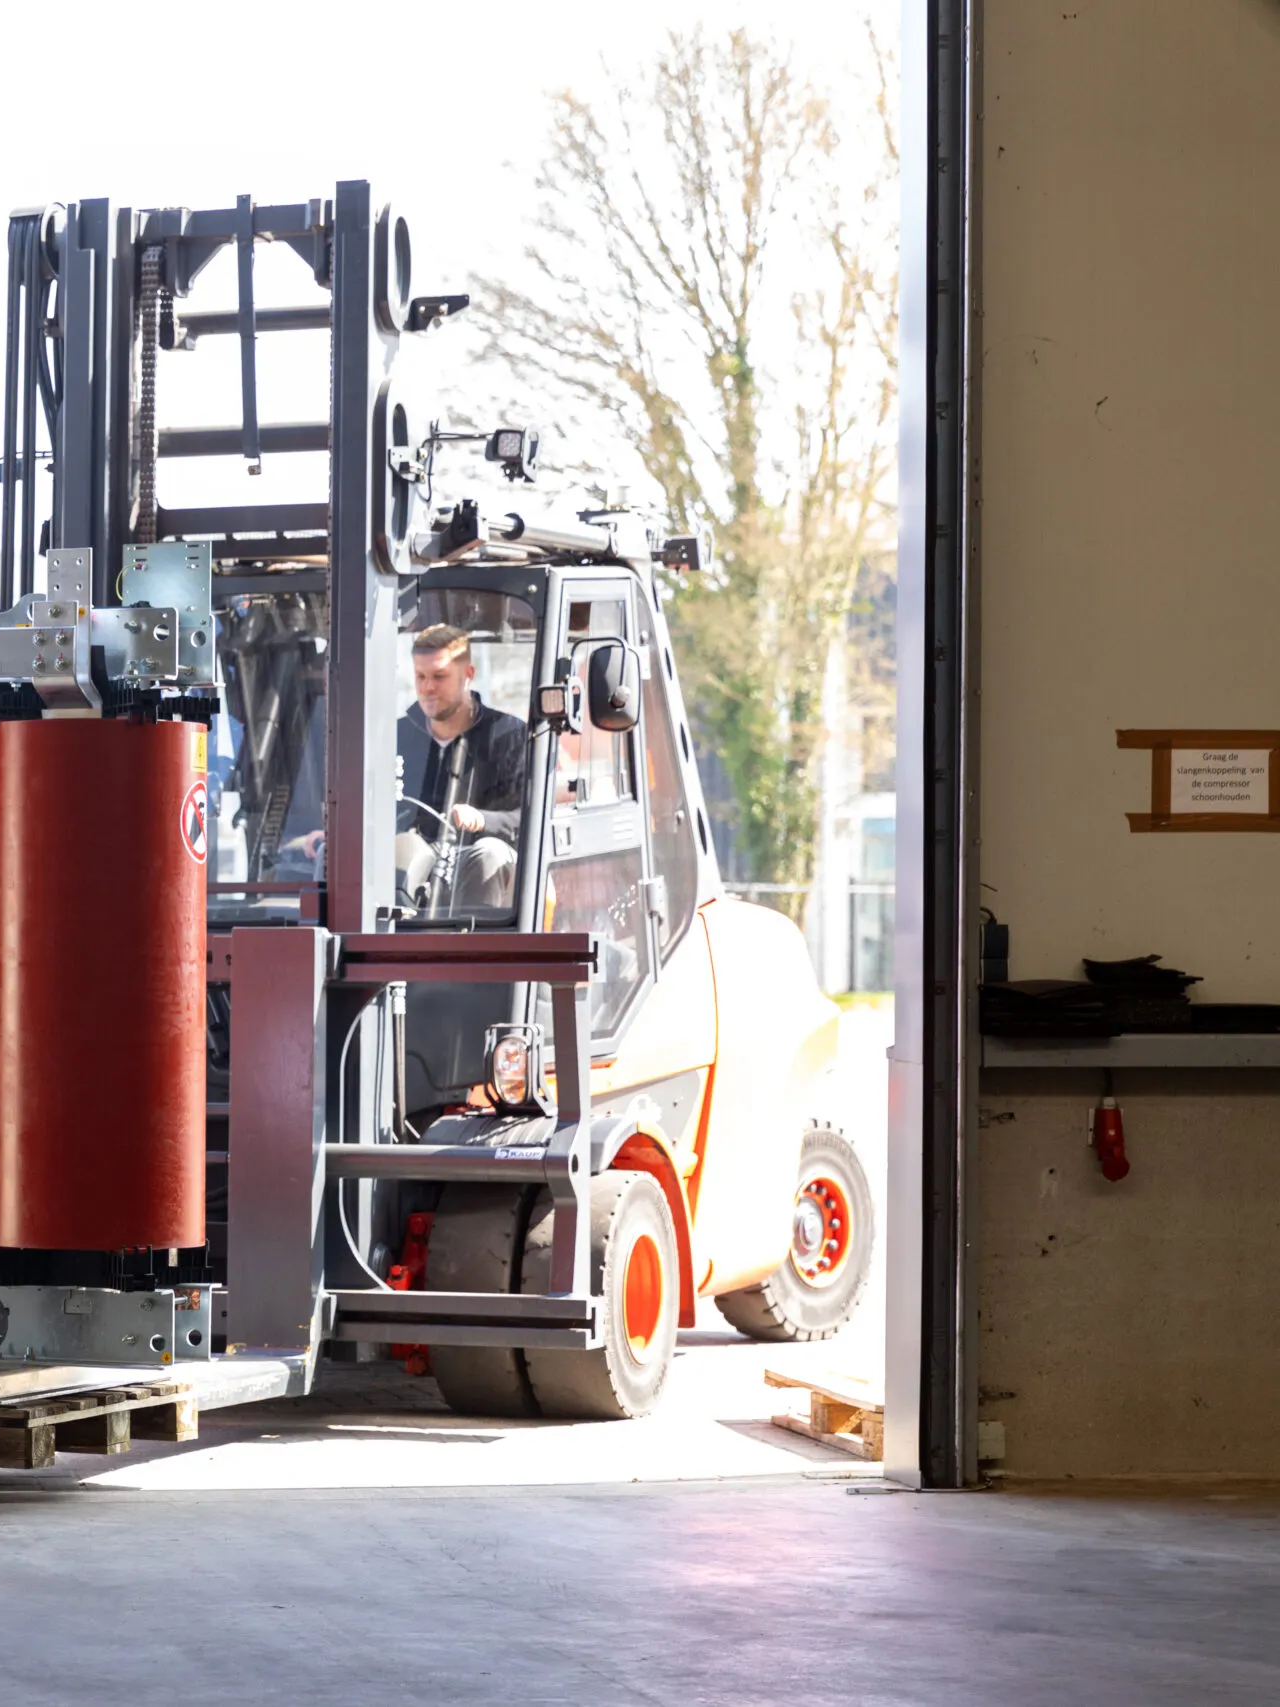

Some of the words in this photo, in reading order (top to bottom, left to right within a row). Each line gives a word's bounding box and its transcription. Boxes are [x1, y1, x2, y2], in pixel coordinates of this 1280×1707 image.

[1202, 752, 1227, 762] Graag
[1228, 752, 1239, 761] de
[1176, 766, 1247, 775] slangenkoppeling
[1191, 780, 1202, 788] de
[1203, 781, 1251, 789] compressor
[1191, 793, 1251, 801] schoonhouden
